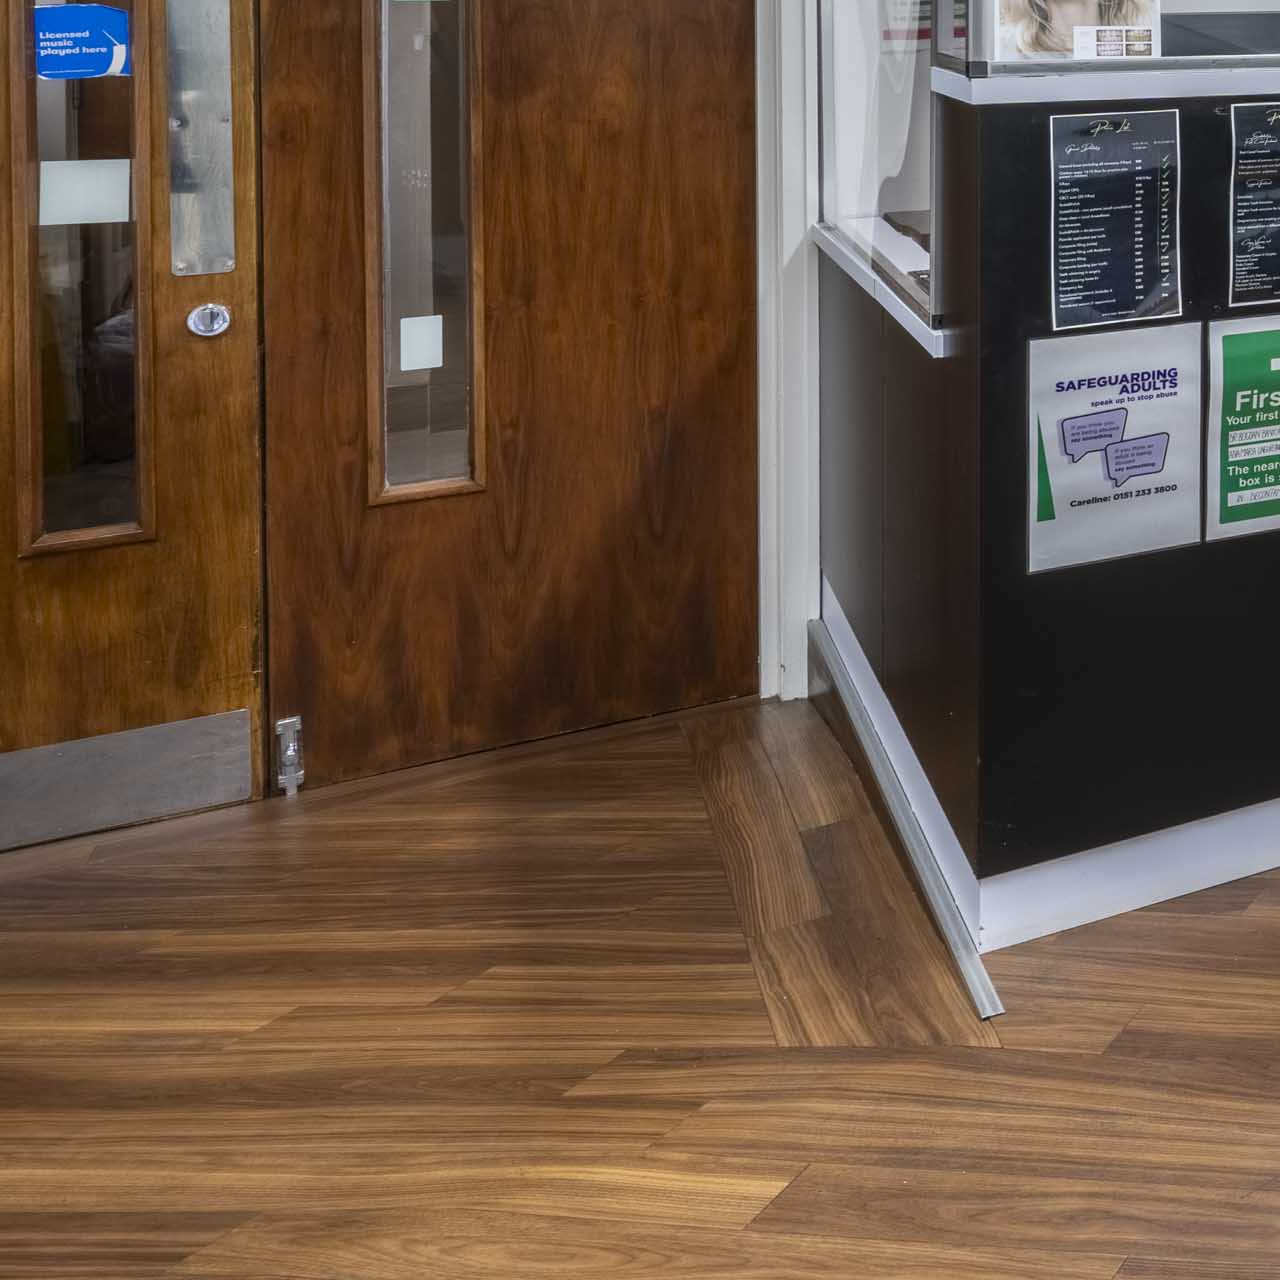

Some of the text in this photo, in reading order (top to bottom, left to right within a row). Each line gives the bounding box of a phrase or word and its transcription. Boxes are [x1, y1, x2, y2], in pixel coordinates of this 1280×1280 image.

[39, 30, 90, 39] Licensed
[40, 47, 80, 56] played
[1055, 368, 1178, 392] SAFEGUARDING
[1119, 378, 1178, 395] ADULTS
[1091, 399, 1113, 407] speak
[1137, 393, 1154, 401] stop
[1156, 391, 1178, 399] abuse
[1226, 415, 1252, 426] Your
[1255, 410, 1279, 422] first
[1227, 465, 1249, 476] The
[1239, 477, 1260, 488] box
[1264, 473, 1275, 483] is
[1070, 496, 1111, 507] Careline:
[1113, 491, 1133, 501] 0151
[1135, 488, 1152, 497] 233
